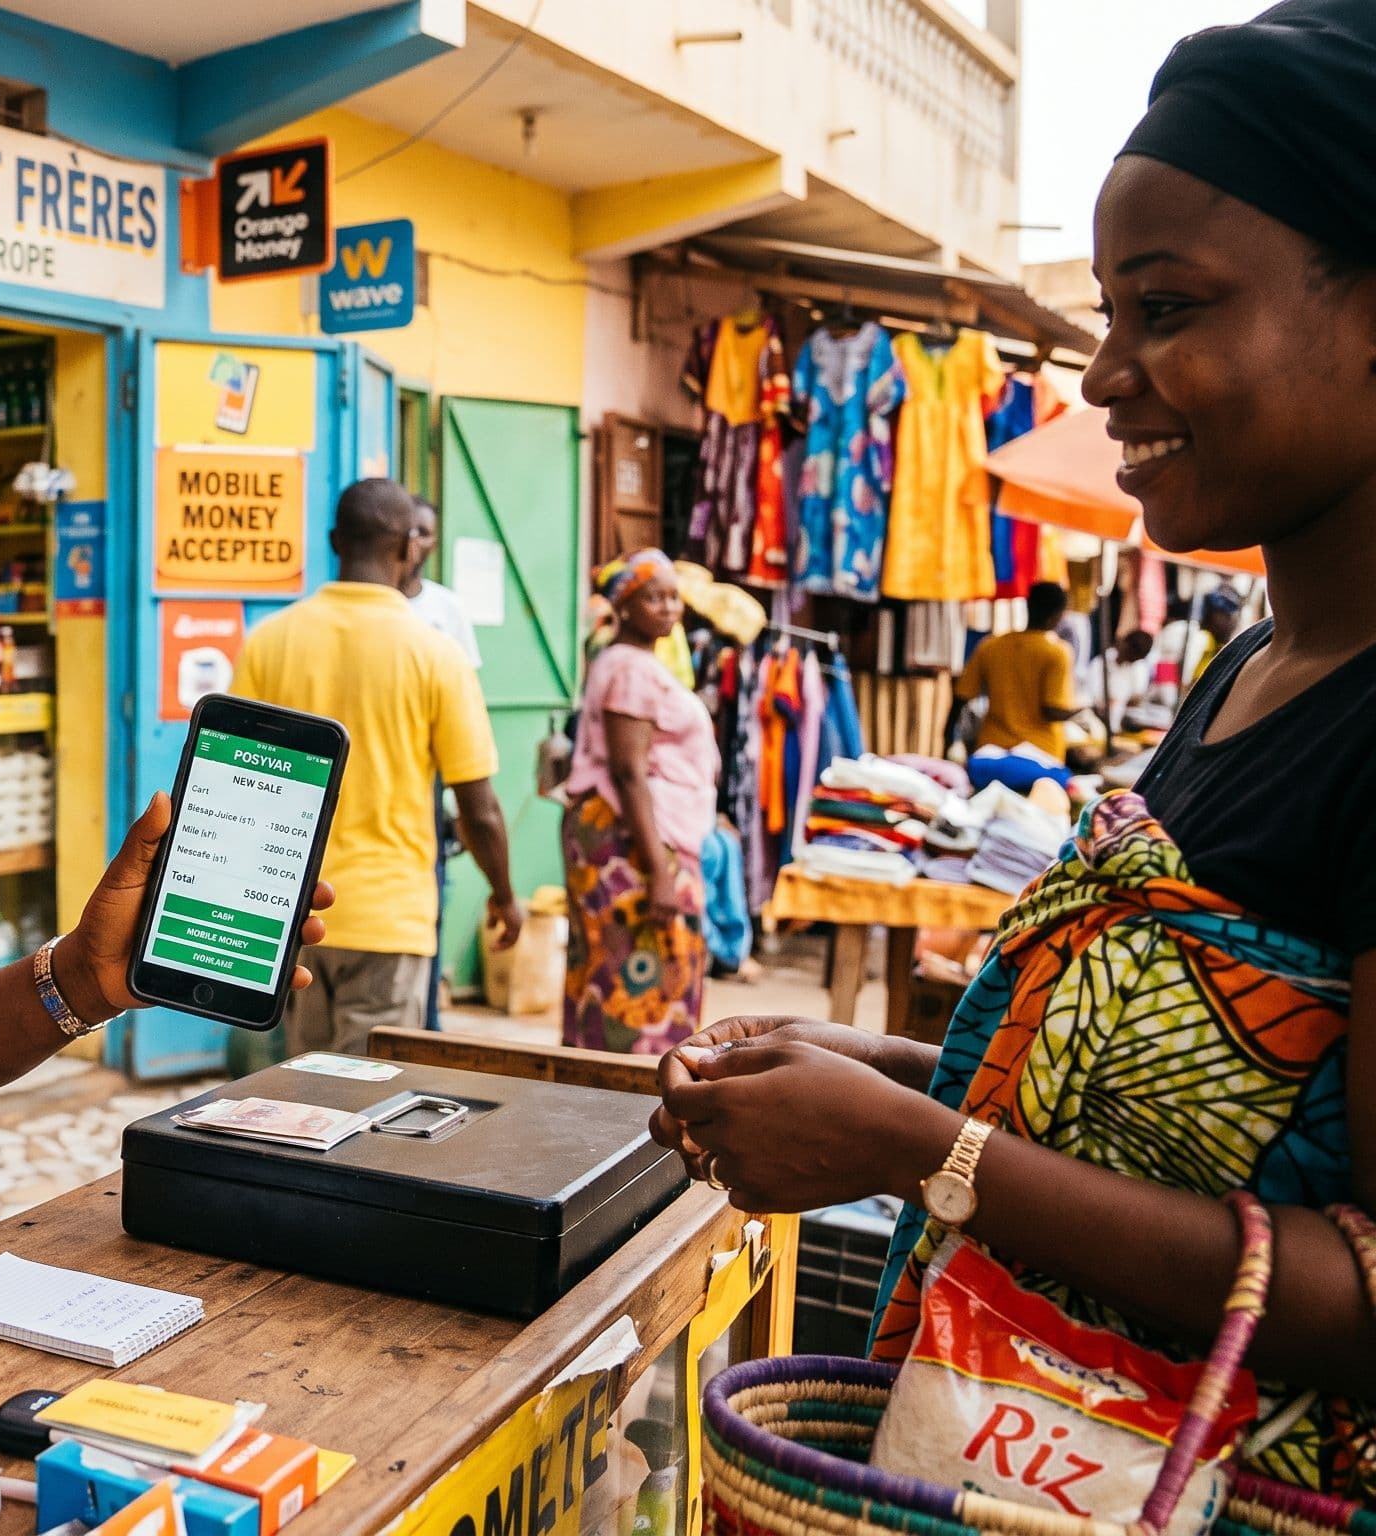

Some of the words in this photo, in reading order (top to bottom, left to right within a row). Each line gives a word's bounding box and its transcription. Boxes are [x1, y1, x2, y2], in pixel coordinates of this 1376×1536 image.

[16, 152, 158, 251] FRÈRES
[328, 282, 403, 311] wave
[178, 471, 284, 498] MOBILE
[183, 505, 277, 530] MONEY
[167, 539, 293, 563] ACCEPTED
[233, 749, 292, 773] POSYVAR
[191, 784, 210, 796] Cart
[232, 775, 256, 789] NEW
[256, 781, 283, 795] SALE
[291, 828, 308, 839] CFA
[176, 844, 211, 860] Nescafe
[279, 870, 297, 881] CFA
[171, 870, 196, 884] Total
[243, 888, 269, 903] 5500
[270, 895, 291, 908] CFA
[449, 1371, 608, 1536] METE
[963, 1402, 1104, 1518] Riz
